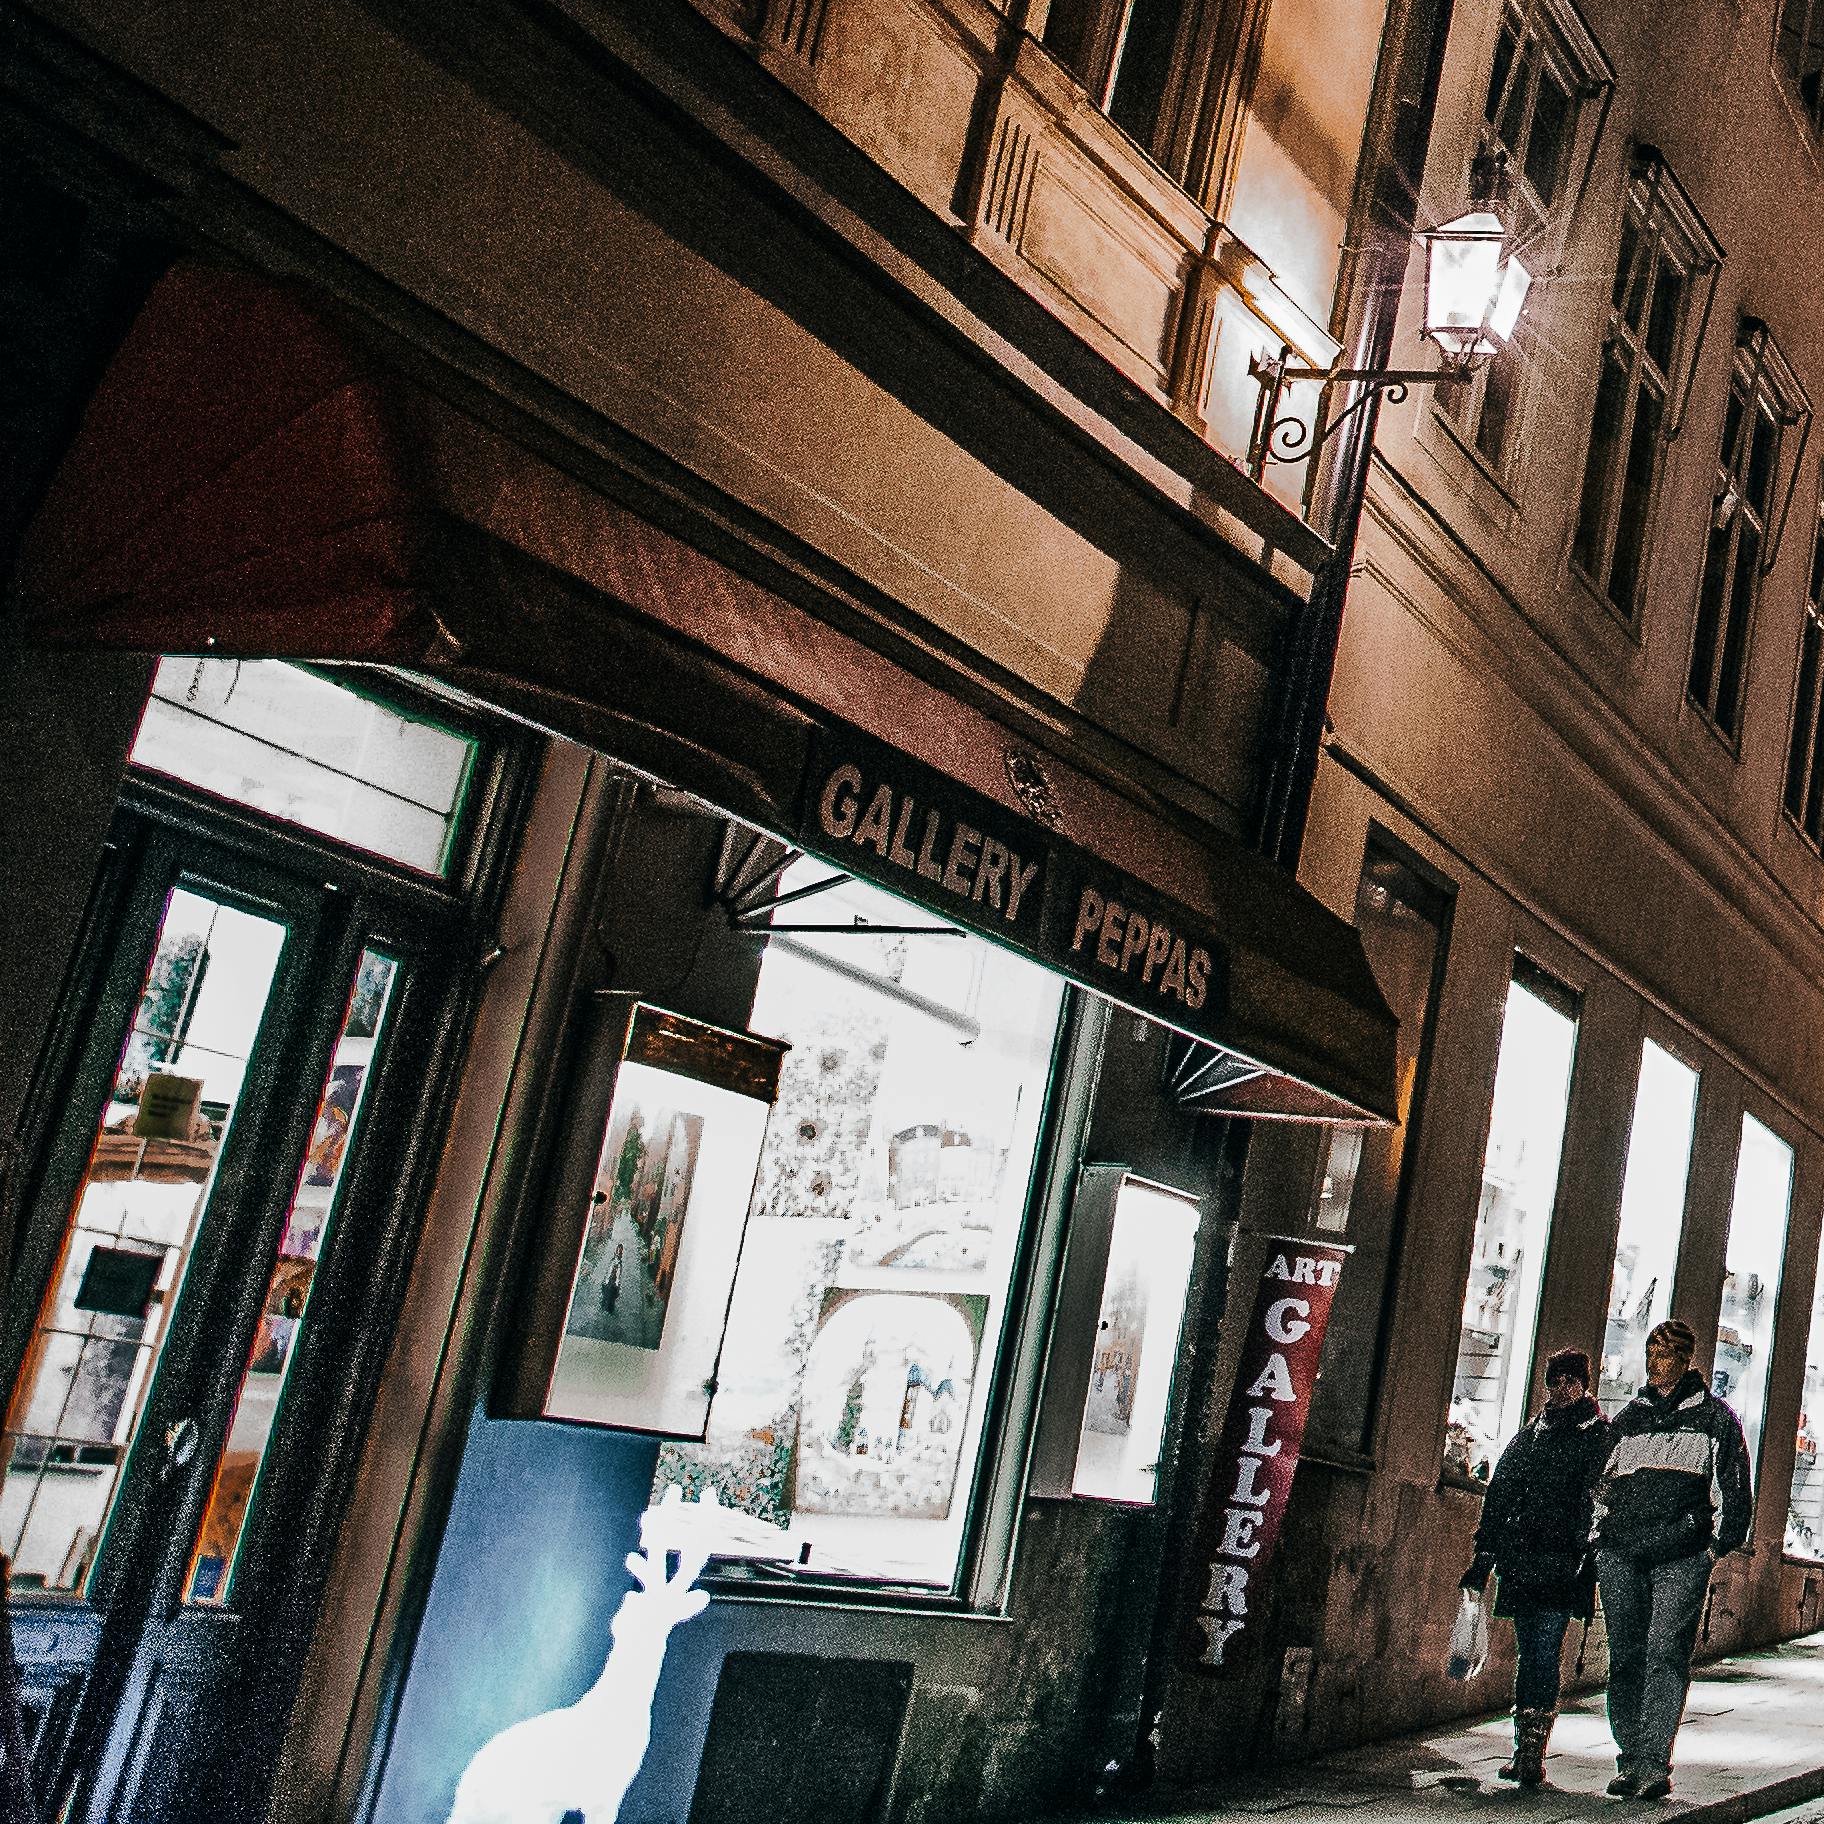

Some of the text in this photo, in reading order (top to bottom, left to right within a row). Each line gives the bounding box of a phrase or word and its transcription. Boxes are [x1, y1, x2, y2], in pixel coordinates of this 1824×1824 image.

[818, 762, 1212, 1010] GALLERY PEPPAS
[1264, 1253, 1342, 1287] ART
[1197, 1297, 1311, 1666] GALLERY
